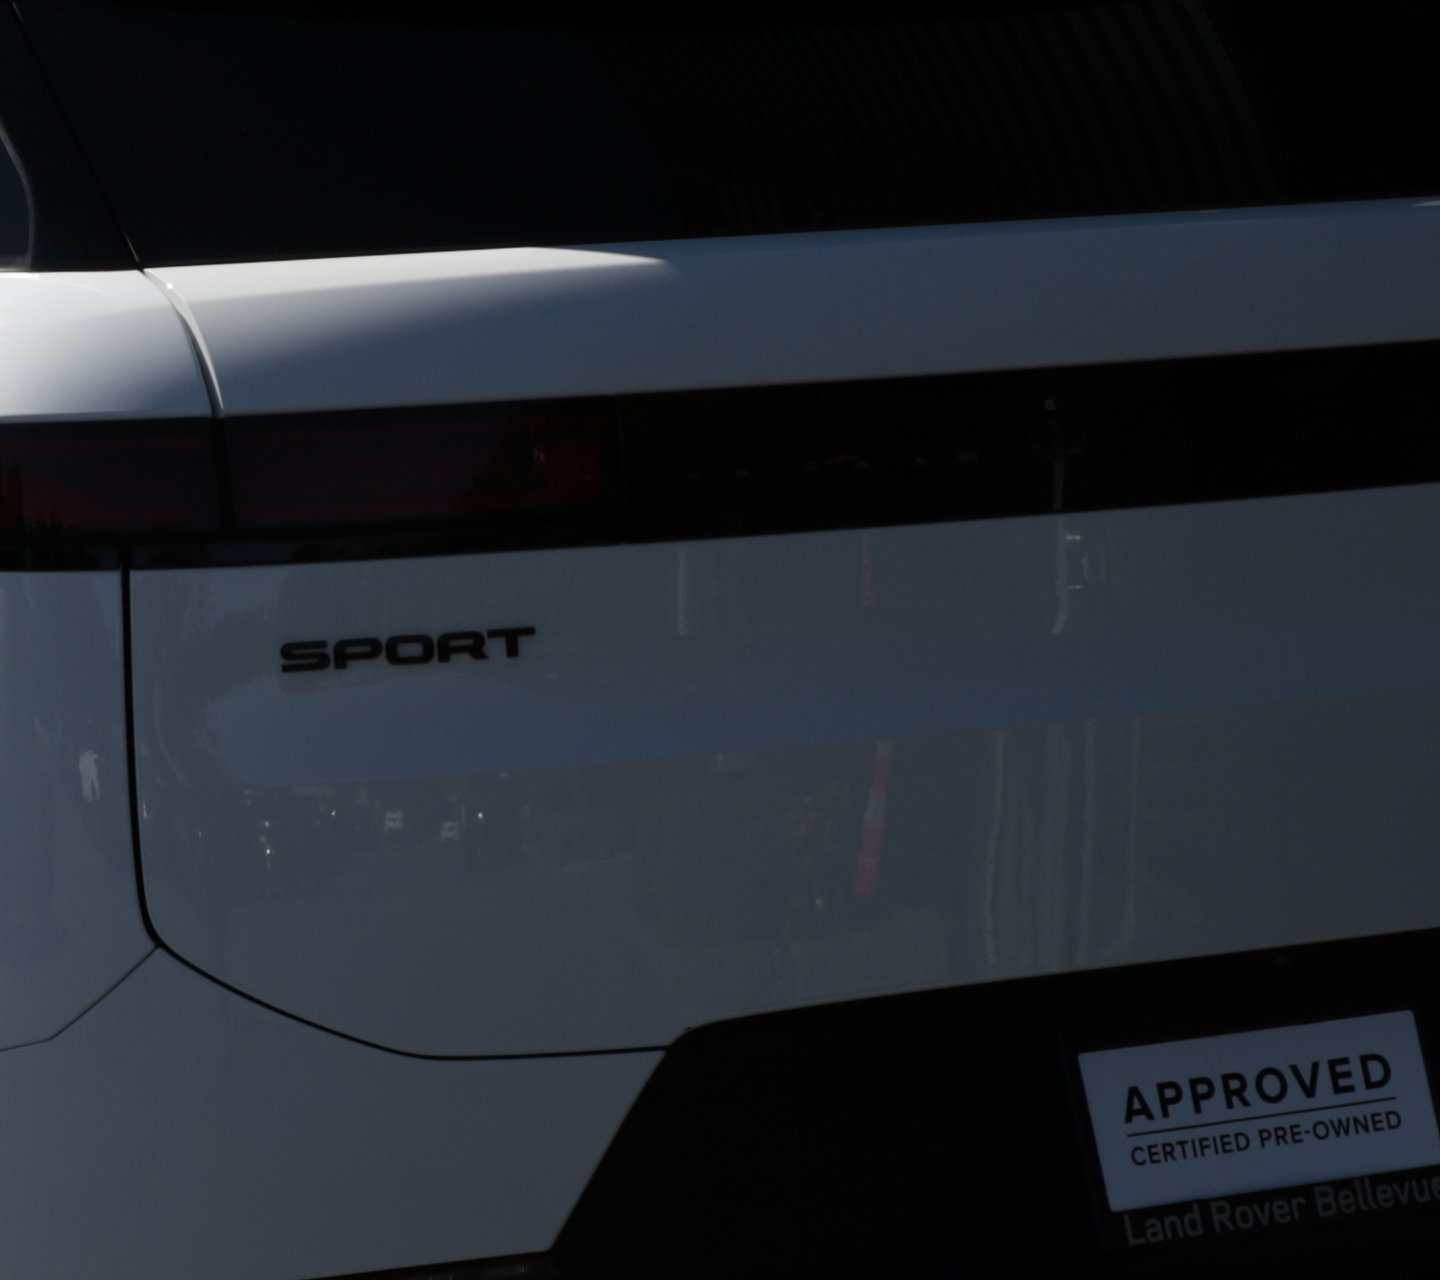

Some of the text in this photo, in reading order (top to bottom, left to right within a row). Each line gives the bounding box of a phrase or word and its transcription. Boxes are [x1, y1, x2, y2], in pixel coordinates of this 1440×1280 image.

[280, 626, 536, 673] SPORT
[1124, 1053, 1392, 1123] APPROVED
[1131, 1110, 1402, 1166] CERTIFIED PRE-OWNED
[1123, 1203, 1204, 1246] Land
[1209, 1193, 1307, 1233] Rover
